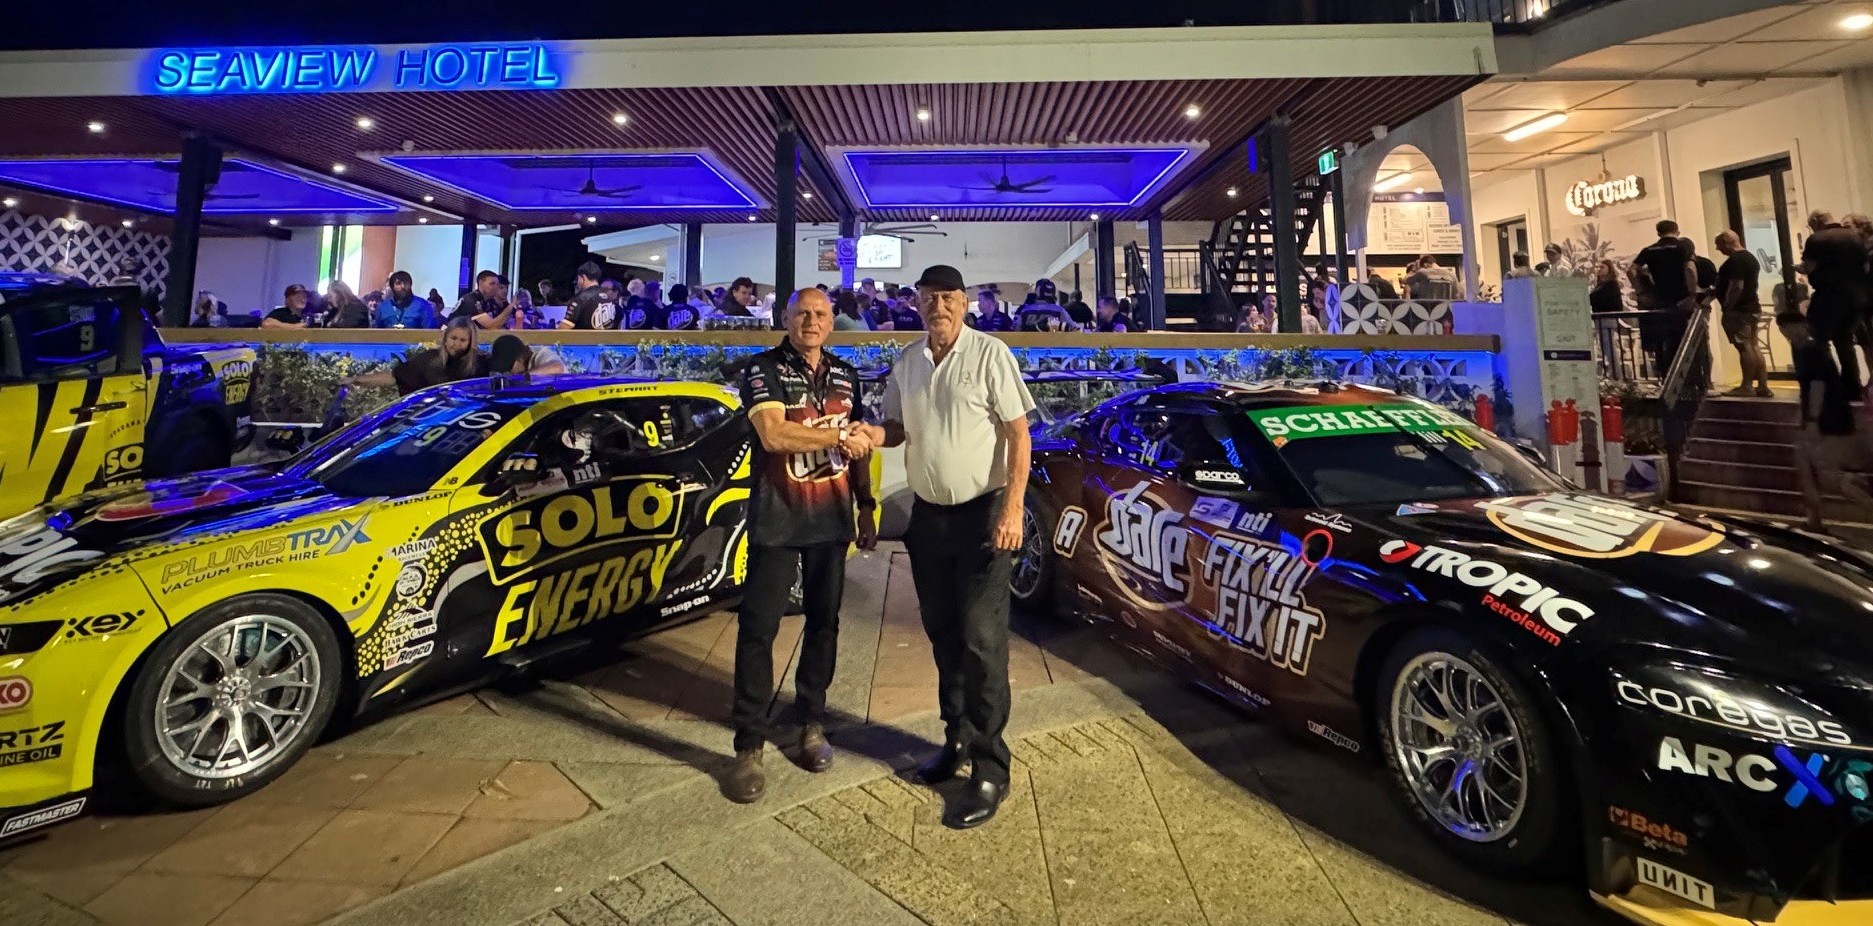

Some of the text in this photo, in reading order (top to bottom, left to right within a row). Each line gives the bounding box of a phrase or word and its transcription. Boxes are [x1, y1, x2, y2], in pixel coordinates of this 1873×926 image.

[155, 45, 559, 92] SEAVIEW HOTEL
[1565, 174, 1640, 217] Corona
[223, 362, 249, 380] SOLO
[414, 426, 448, 447] 9
[643, 420, 660, 447] 9
[1442, 429, 1487, 450] 14
[1140, 439, 1159, 467] 14
[1195, 469, 1244, 484] sparco
[393, 491, 452, 507] DUNLOP
[495, 481, 674, 567] SOLO
[1056, 481, 1191, 592] A dare
[1237, 512, 1273, 534] nti
[161, 549, 321, 595] VACUUM TRUCK HIRE
[1204, 535, 1306, 600] FIX'LL
[484, 539, 684, 658] ENERGY
[1411, 545, 1596, 635] TROPIC
[660, 595, 710, 618] Snap-on
[1481, 594, 1561, 647] Petroleum
[1215, 586, 1272, 646] FIX
[1272, 607, 1320, 664] IT
[397, 643, 432, 662] Repco
[1225, 676, 1272, 706] DUNLOP
[1617, 679, 1852, 746] coregas
[1324, 726, 1359, 751] Repco
[31, 747, 57, 761] OIL
[6, 802, 80, 832] FASTMASTER
[1631, 814, 1688, 847] Beta
